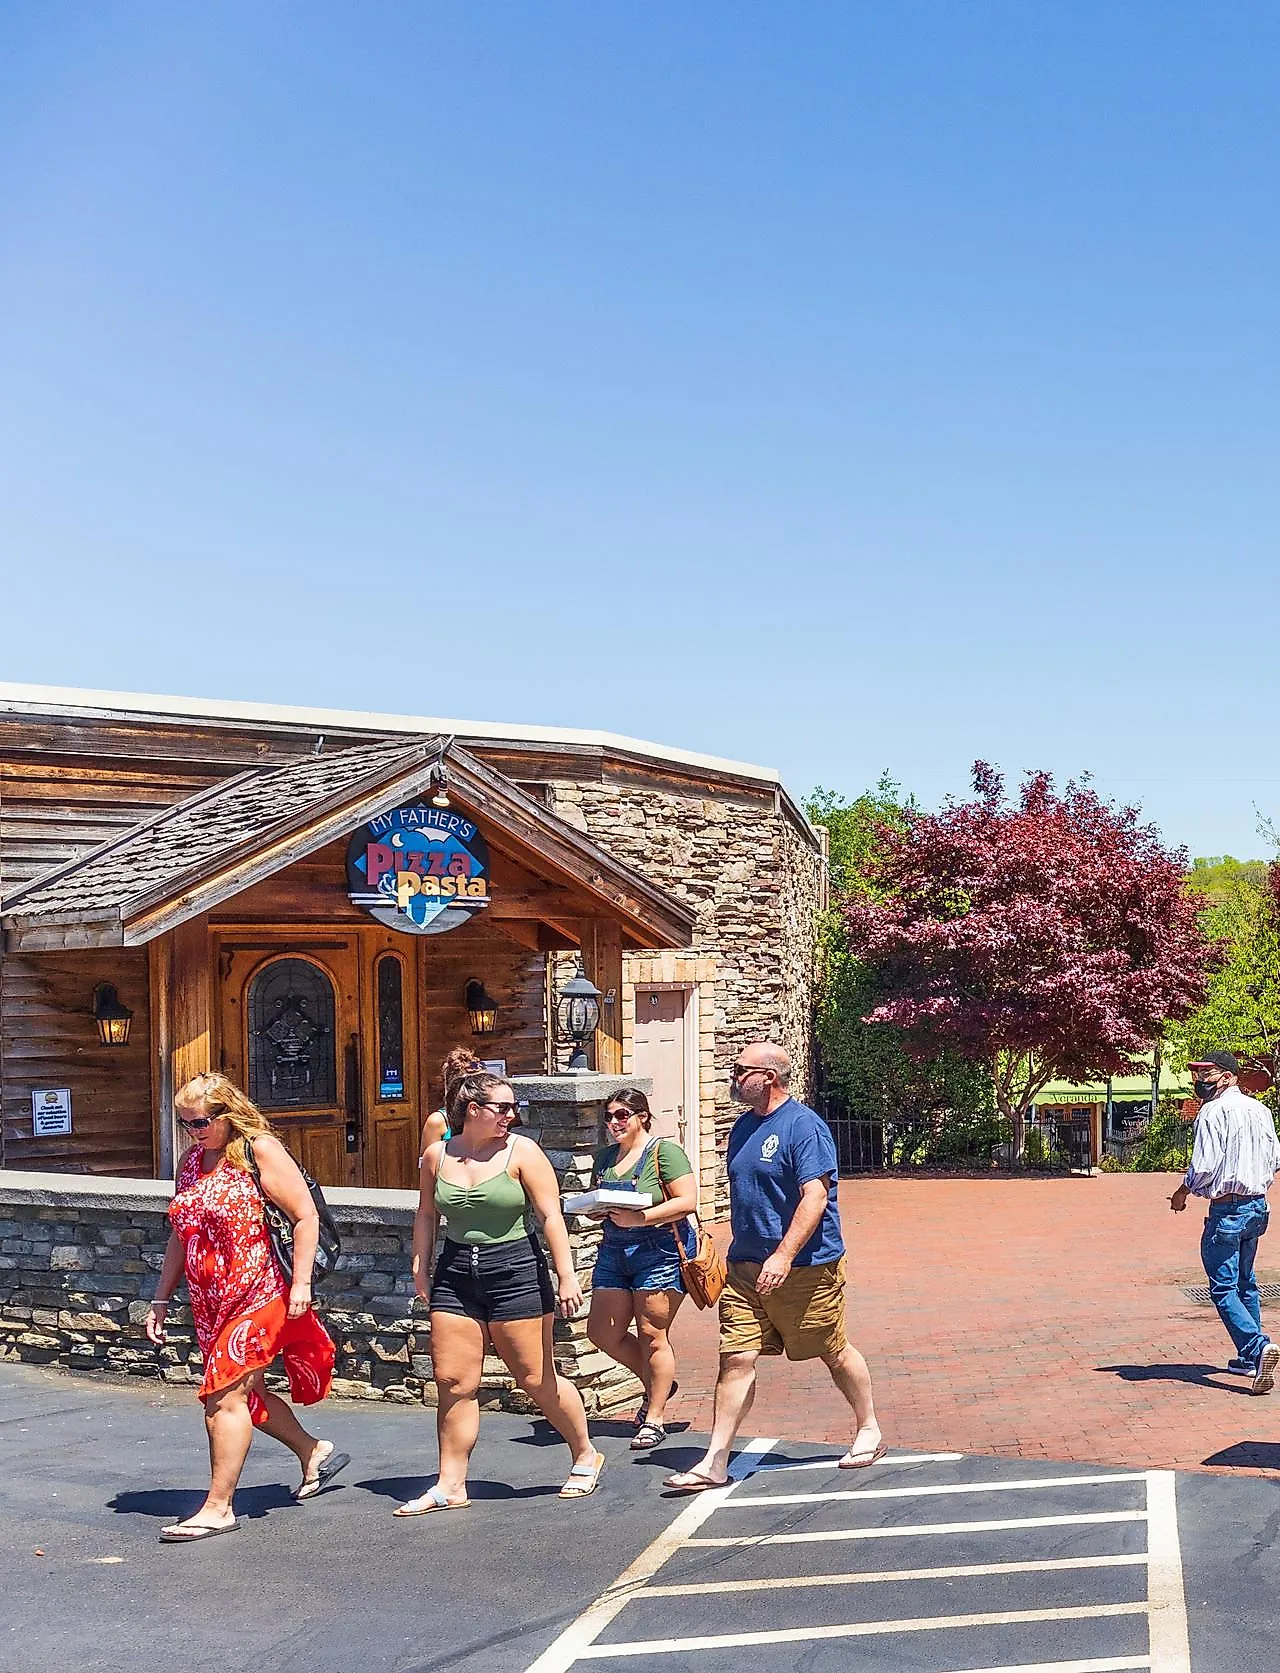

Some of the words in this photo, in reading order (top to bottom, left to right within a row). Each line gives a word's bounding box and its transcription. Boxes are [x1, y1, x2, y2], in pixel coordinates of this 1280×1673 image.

[371, 812, 393, 833] MY
[399, 809, 473, 837] FATHER'S
[367, 843, 472, 886] Pizza
[377, 873, 399, 897] &
[397, 870, 487, 908] Pasta
[1052, 1093, 1098, 1103] Veranda
